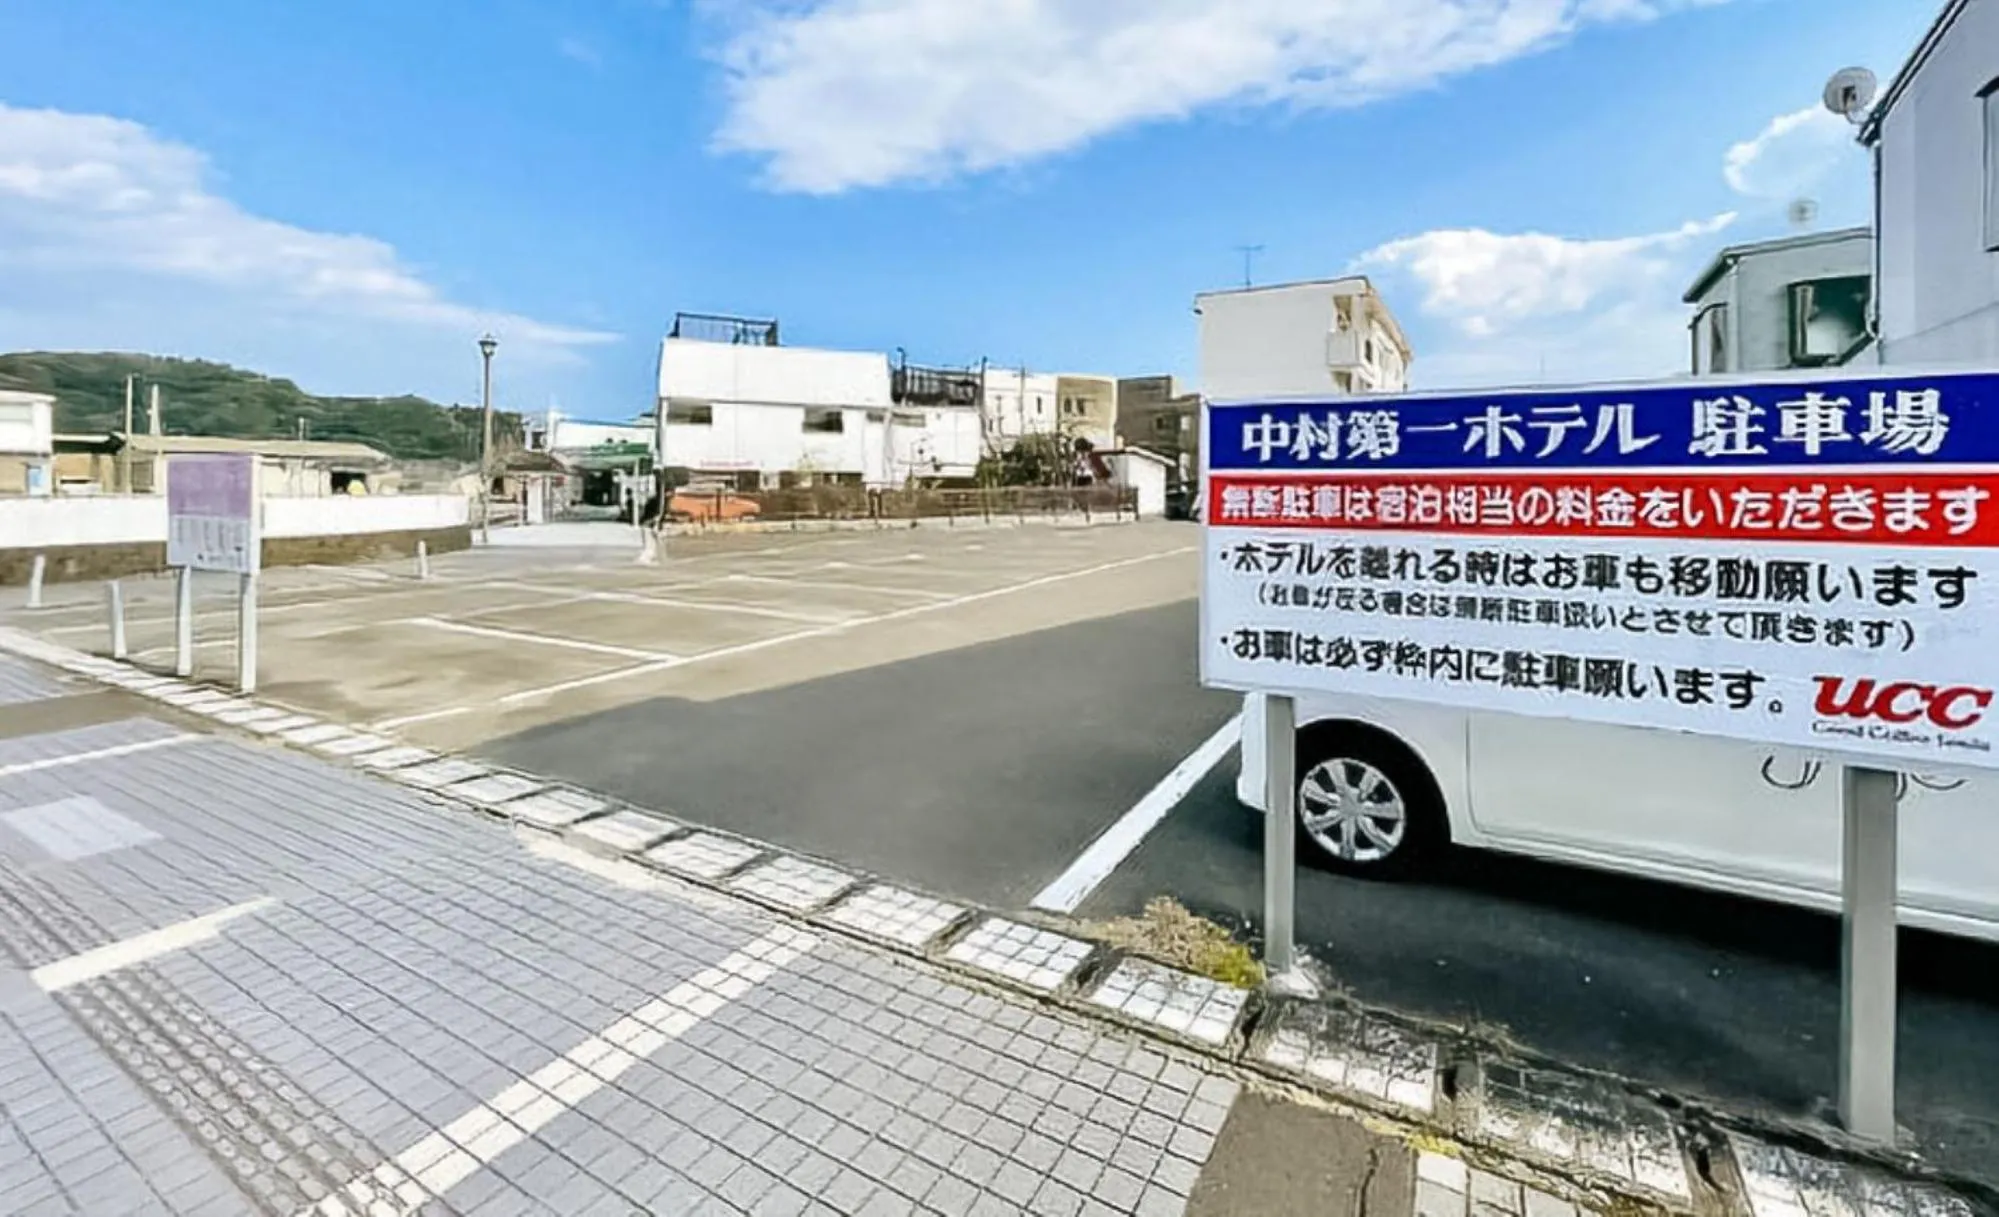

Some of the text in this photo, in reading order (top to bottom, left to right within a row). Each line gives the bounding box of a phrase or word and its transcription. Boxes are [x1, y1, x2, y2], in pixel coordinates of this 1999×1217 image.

[1241, 389, 1950, 462] 中村第一ホテル 駐車場
[1221, 483, 1990, 535] 無断駐車は宿泊相当の料金をいただきます
